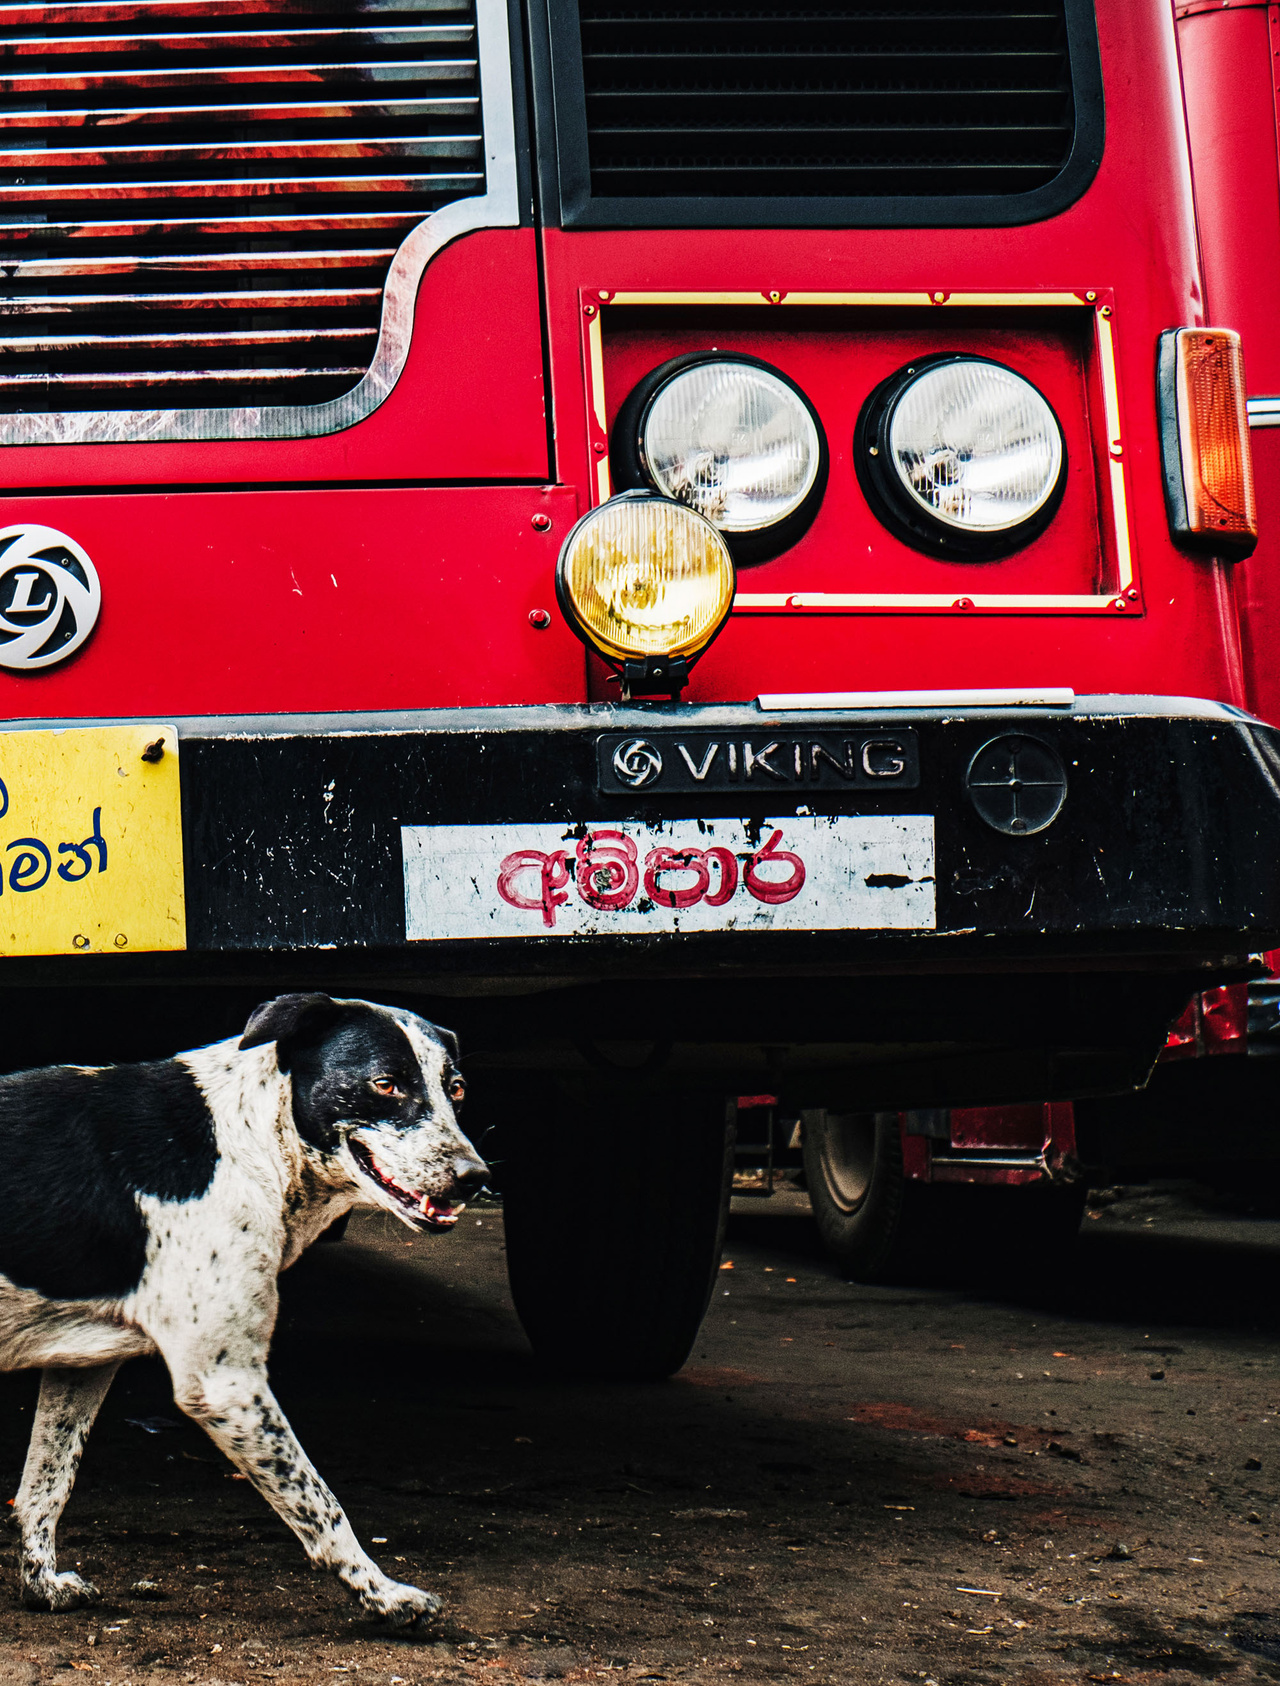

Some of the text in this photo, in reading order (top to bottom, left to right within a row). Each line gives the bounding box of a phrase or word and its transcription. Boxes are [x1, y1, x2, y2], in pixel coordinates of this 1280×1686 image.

[5, 572, 52, 613] L
[674, 740, 905, 780] VIKING
[497, 829, 806, 927] අම්පාර
